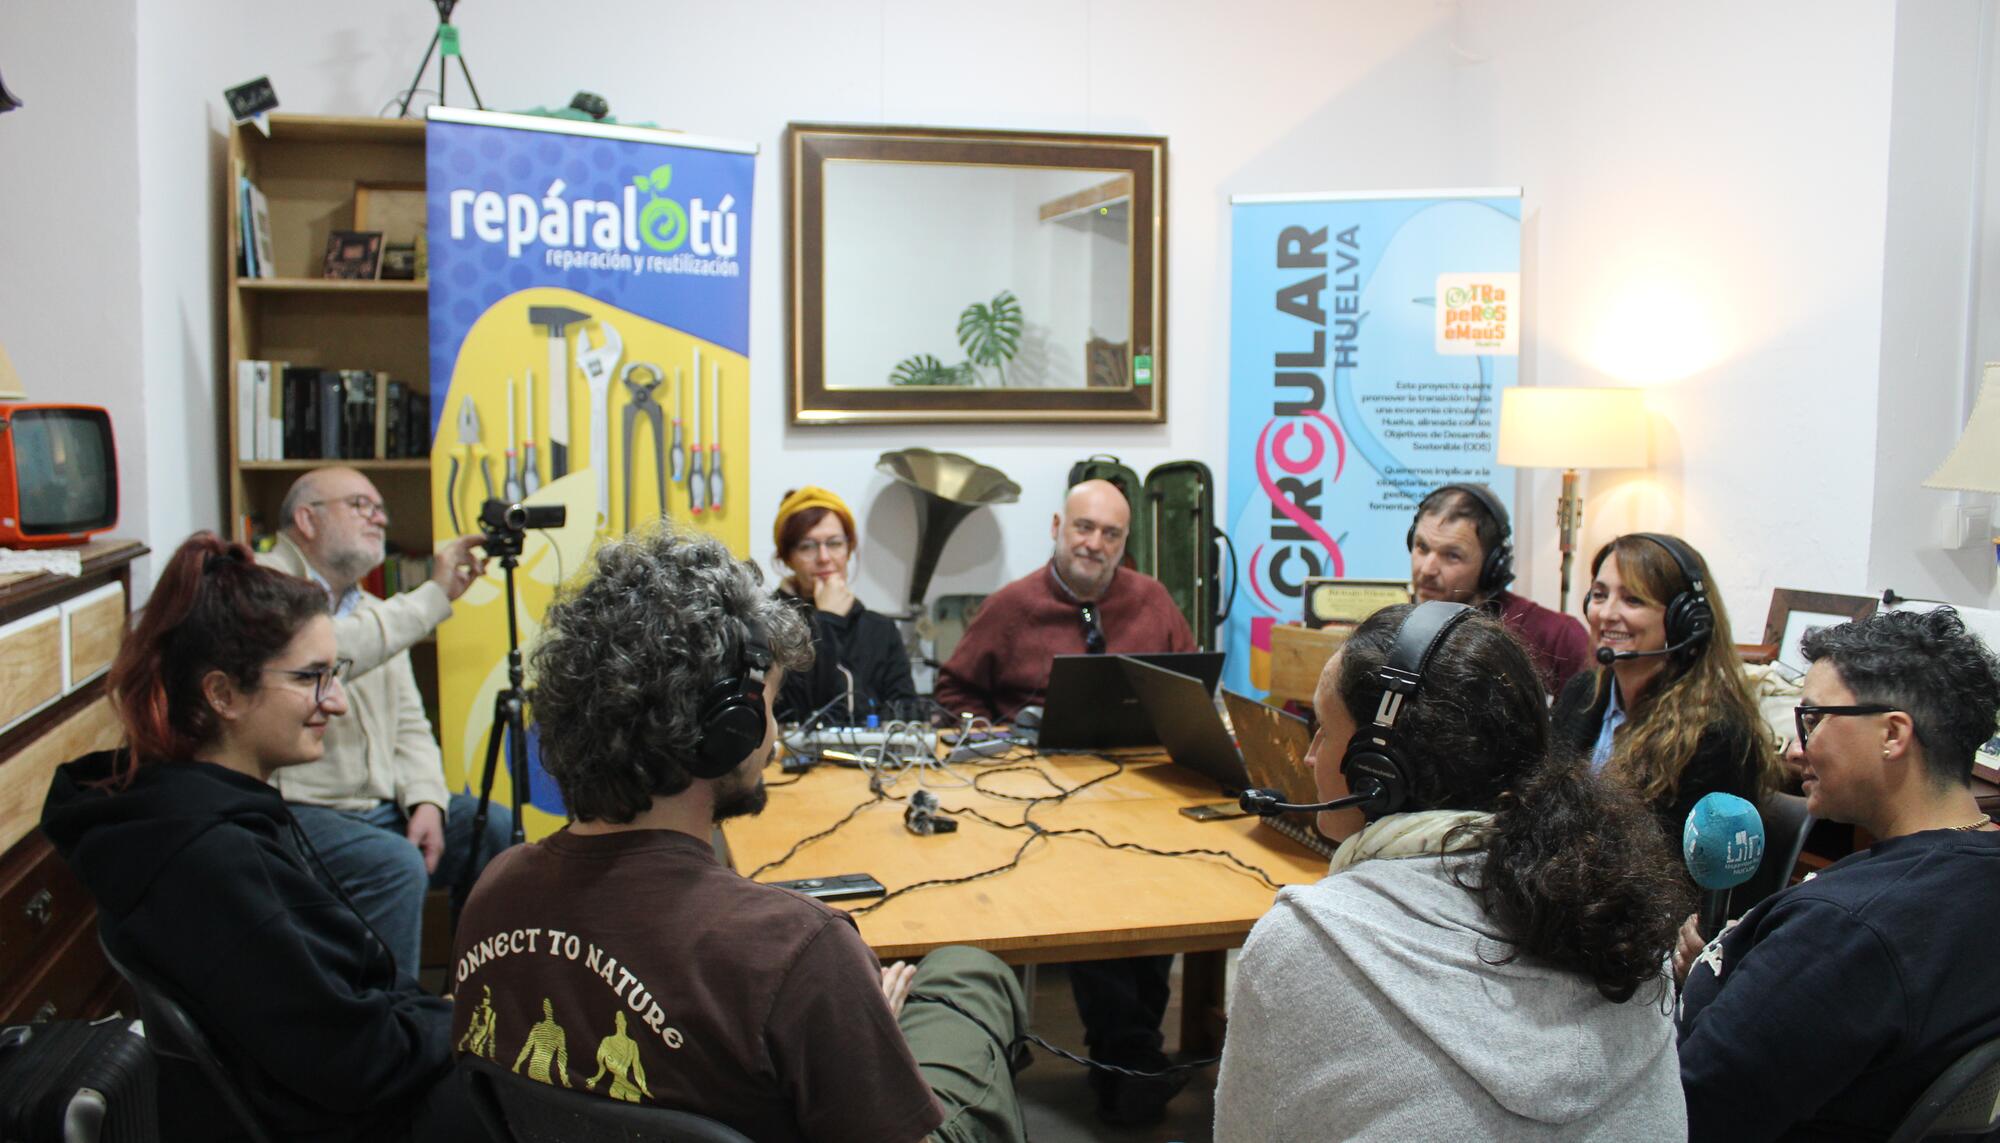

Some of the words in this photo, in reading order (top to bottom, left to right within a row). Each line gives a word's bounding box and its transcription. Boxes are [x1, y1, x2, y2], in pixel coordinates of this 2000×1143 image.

[546, 249, 632, 273] reparación
[633, 255, 645, 275] y
[646, 252, 740, 277] reutilización
[1335, 225, 1360, 368] HUELVA
[1418, 382, 1458, 392] proyecto
[1462, 382, 1492, 392] quiere
[1362, 395, 1406, 403] promover
[1418, 394, 1465, 402] transición
[1269, 225, 1328, 598] CIRCULAR
[1394, 405, 1441, 414] economía
[1384, 429, 1429, 440] Objetivos
[1430, 430, 1441, 438] de
[1443, 430, 1491, 439] Desarrollo
[1413, 442, 1461, 451] Sostenible
[1385, 466, 1433, 476] Queremos
[1435, 466, 1473, 477] implicar
[1369, 502, 1418, 511] fomentan
[455, 928, 541, 995] ONNECT
[548, 929, 581, 961] TO
